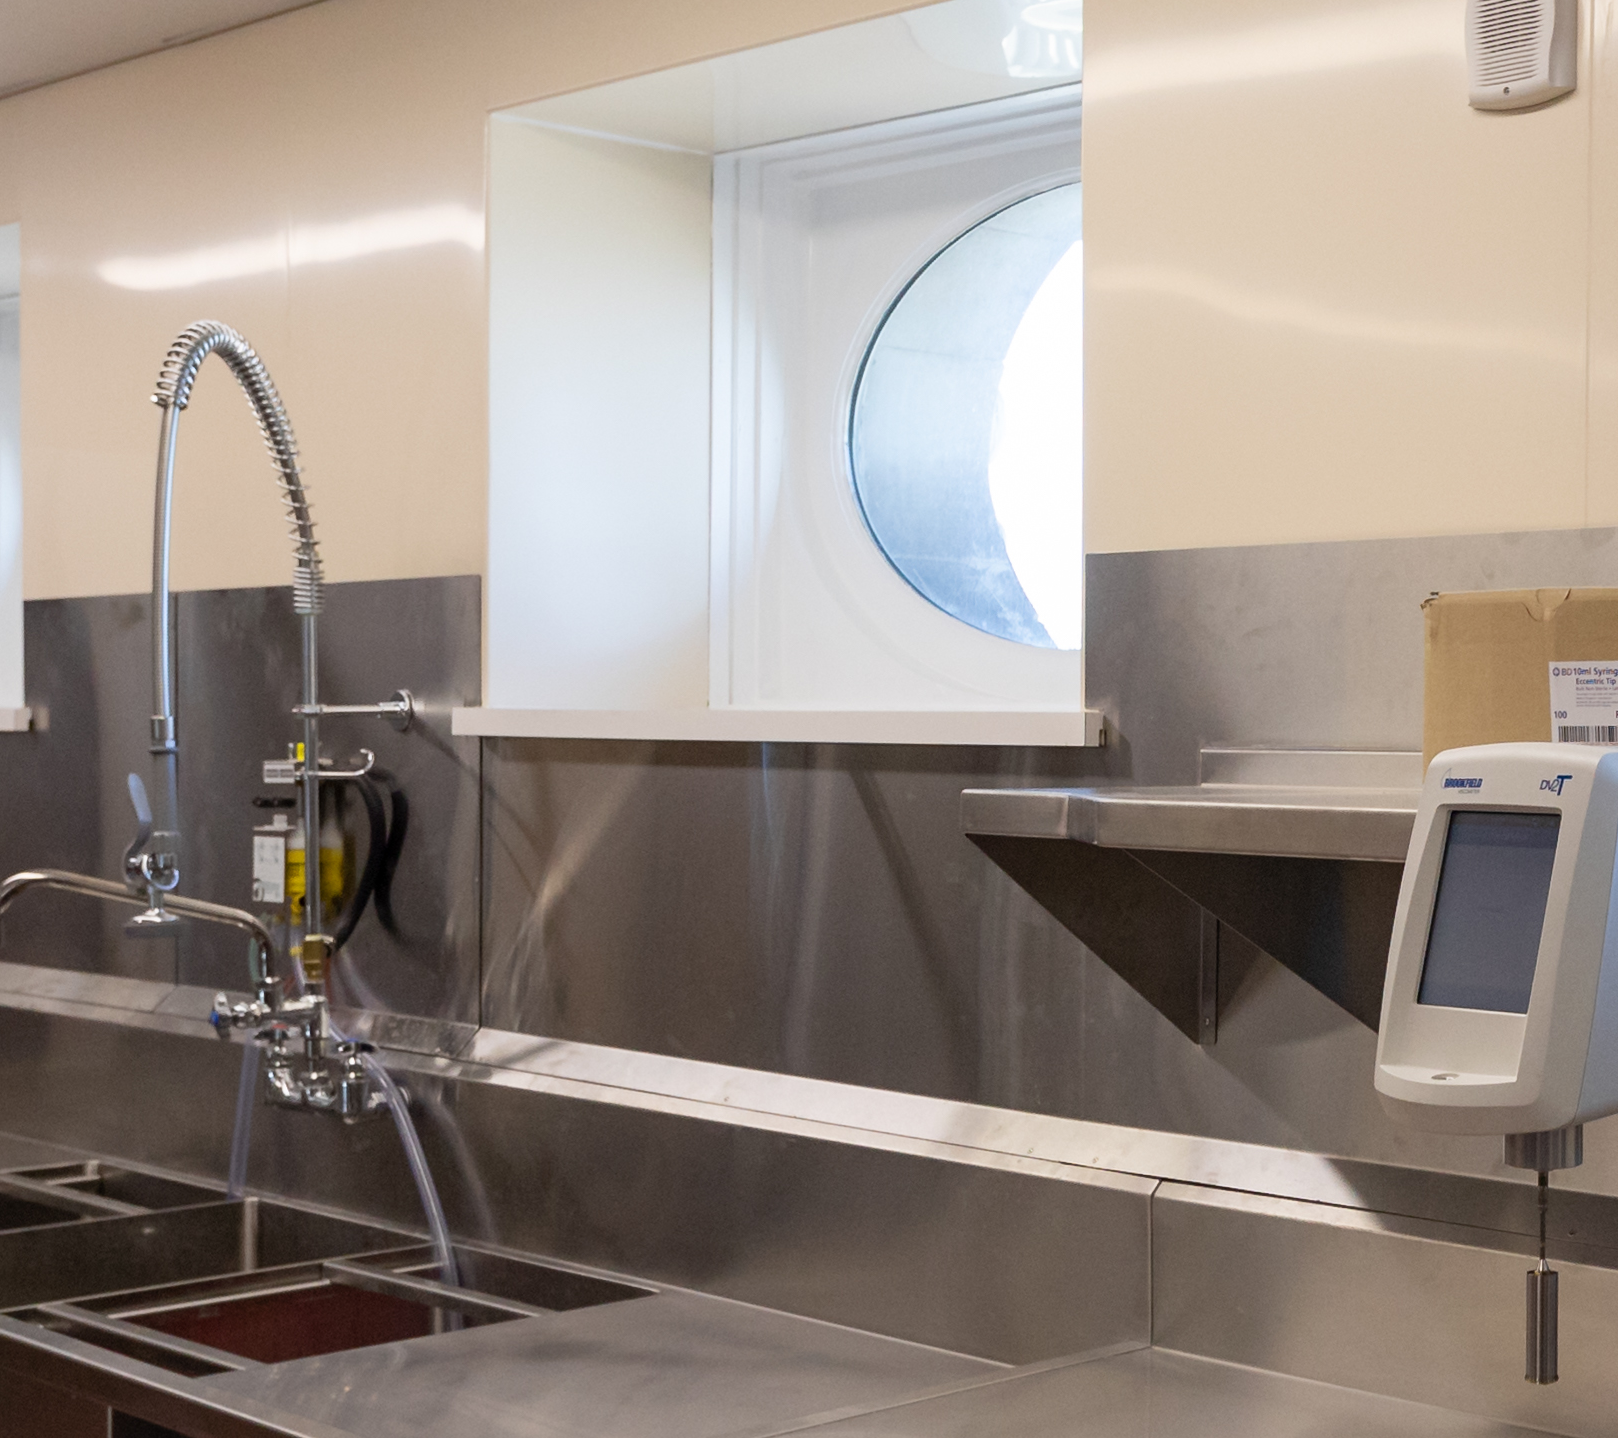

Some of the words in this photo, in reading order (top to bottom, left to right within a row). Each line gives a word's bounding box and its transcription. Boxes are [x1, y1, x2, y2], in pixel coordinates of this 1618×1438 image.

[1606, 678, 1616, 686] Tip
[1554, 711, 1568, 719] 100
[1444, 778, 1483, 788] BROOKFIELD
